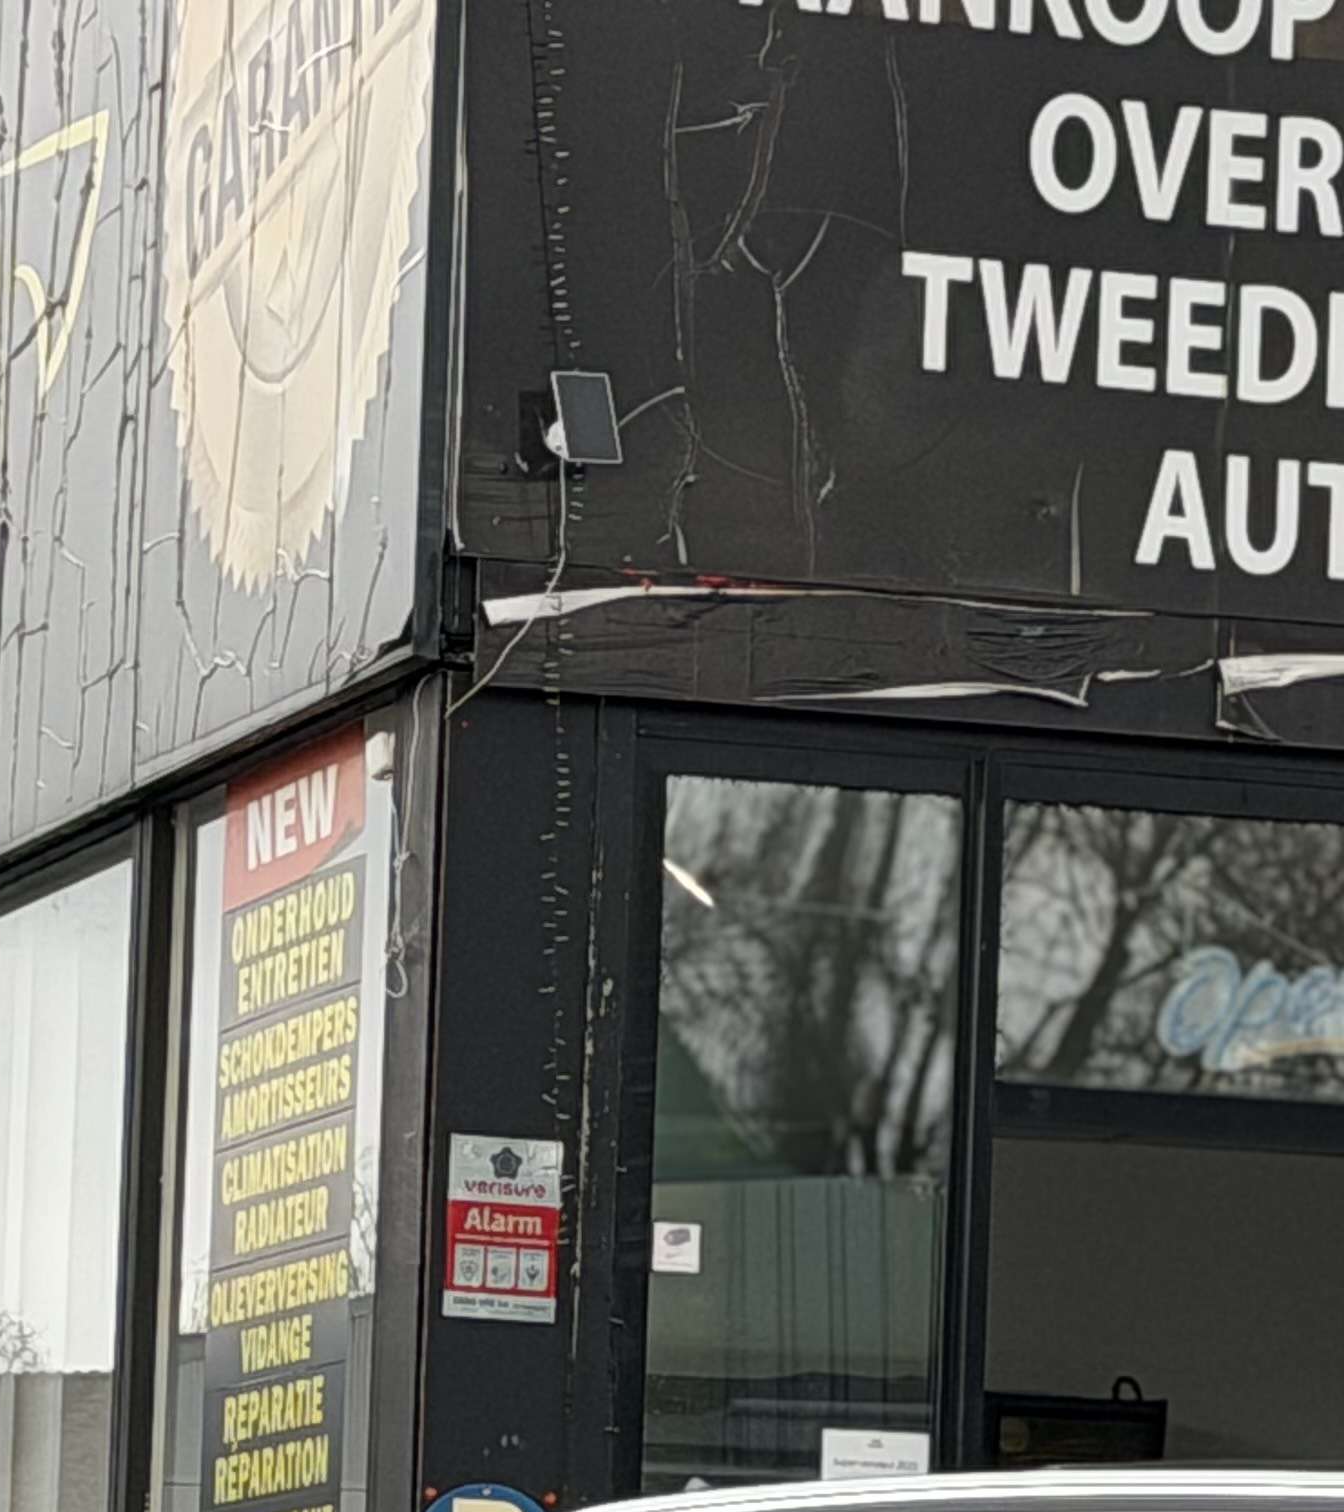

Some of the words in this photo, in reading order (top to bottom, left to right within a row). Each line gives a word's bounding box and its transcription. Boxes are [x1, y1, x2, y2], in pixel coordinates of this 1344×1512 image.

[186, 0, 402, 281] GARAN
[245, 764, 341, 871] NEW
[231, 871, 354, 965] ONDERHOUD
[237, 928, 344, 1015] ENTRETIEN
[219, 996, 358, 1089] SCHOKDEMPERS
[221, 1053, 352, 1141] AMORTISSEURS
[221, 1124, 347, 1206] CLIMATISATION
[234, 1185, 329, 1256] RADIATEUR
[464, 1205, 542, 1236] Alarm
[210, 1249, 349, 1327] OLIEVERVERSING
[240, 1313, 313, 1374] VIDANGE
[223, 1374, 325, 1445] REPARATIE
